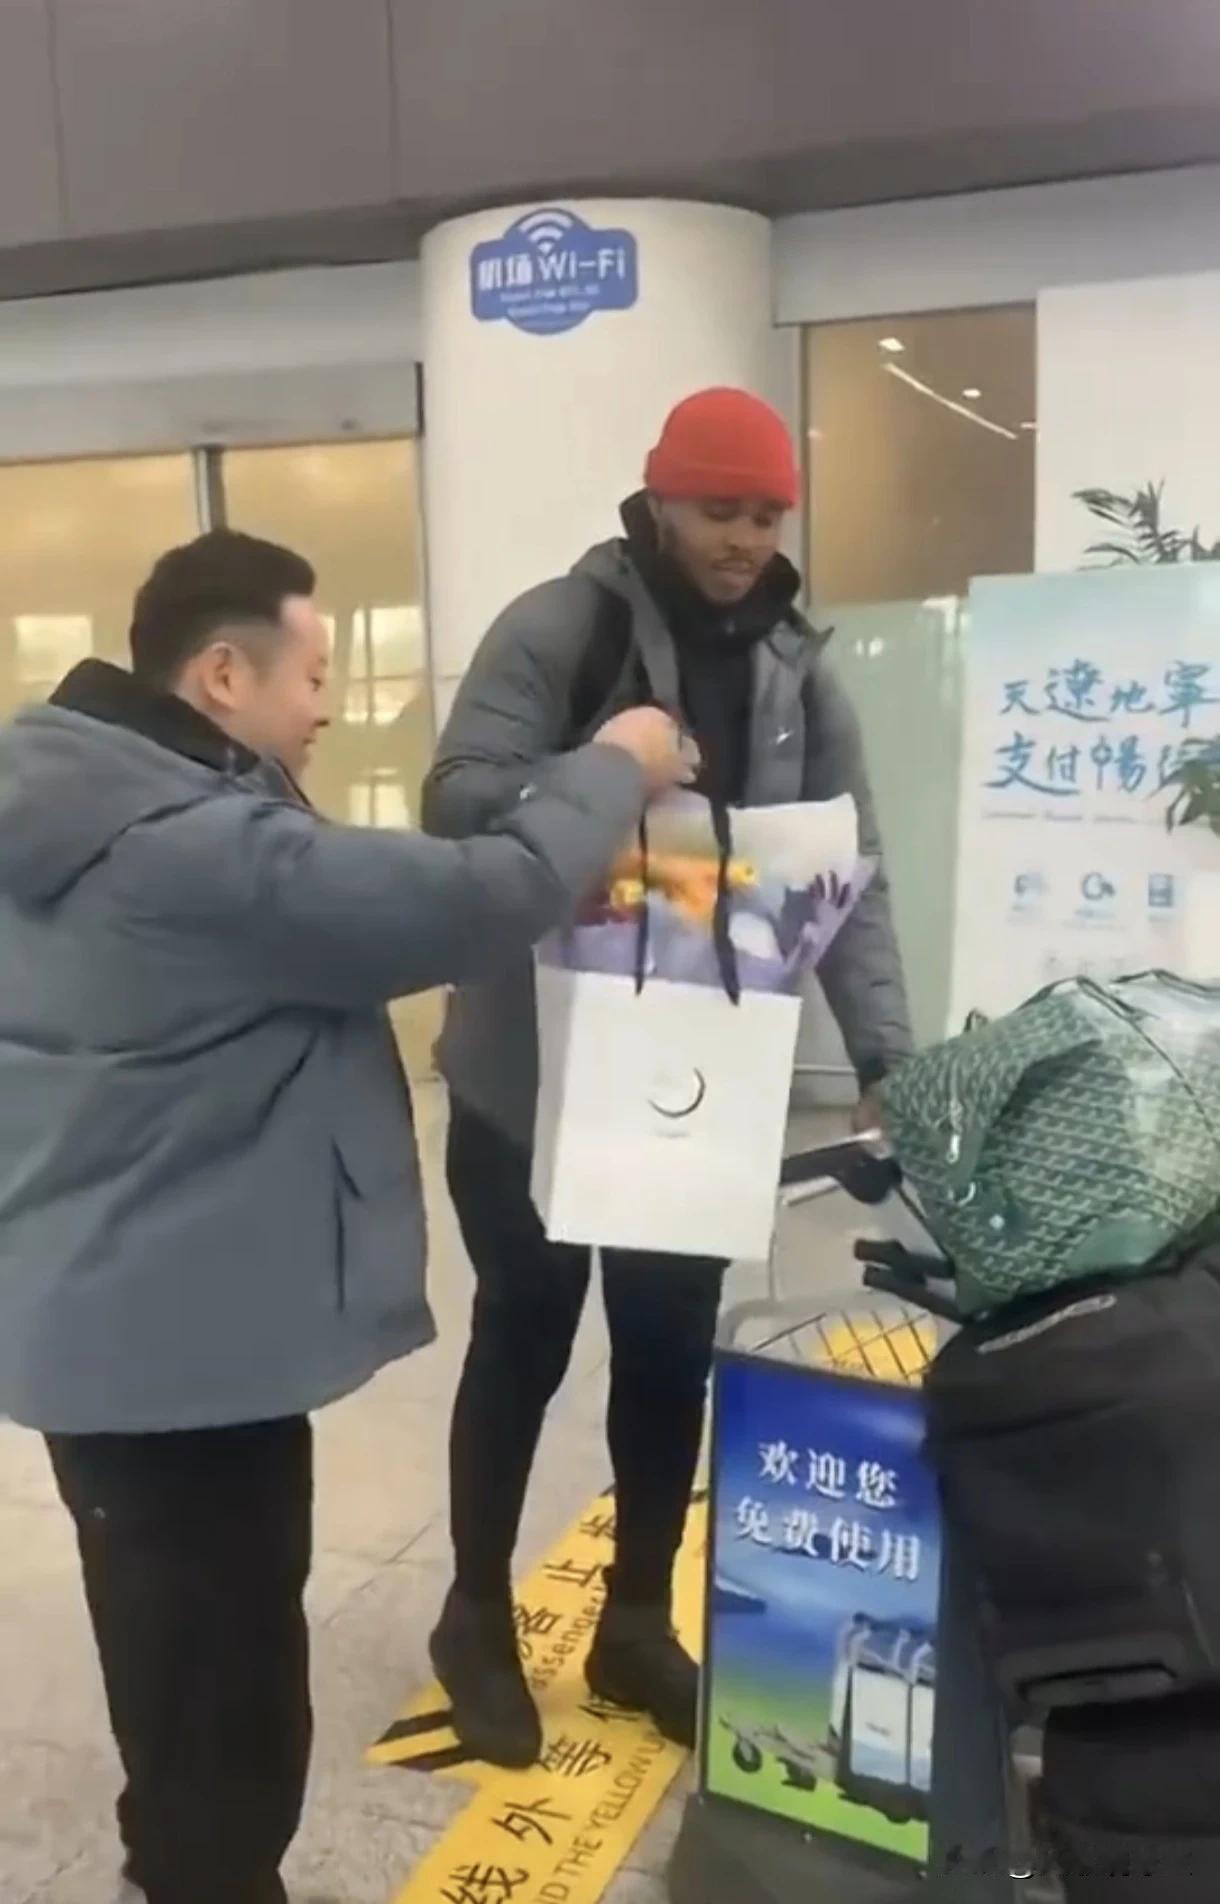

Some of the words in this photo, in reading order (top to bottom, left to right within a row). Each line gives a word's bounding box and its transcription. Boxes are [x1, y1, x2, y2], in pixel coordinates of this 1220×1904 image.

[758, 1440, 897, 1510] 欢迎您
[735, 1496, 920, 1581] 免费使用
[553, 1836, 603, 1878] THE
[584, 1754, 653, 1831] YELLOW
